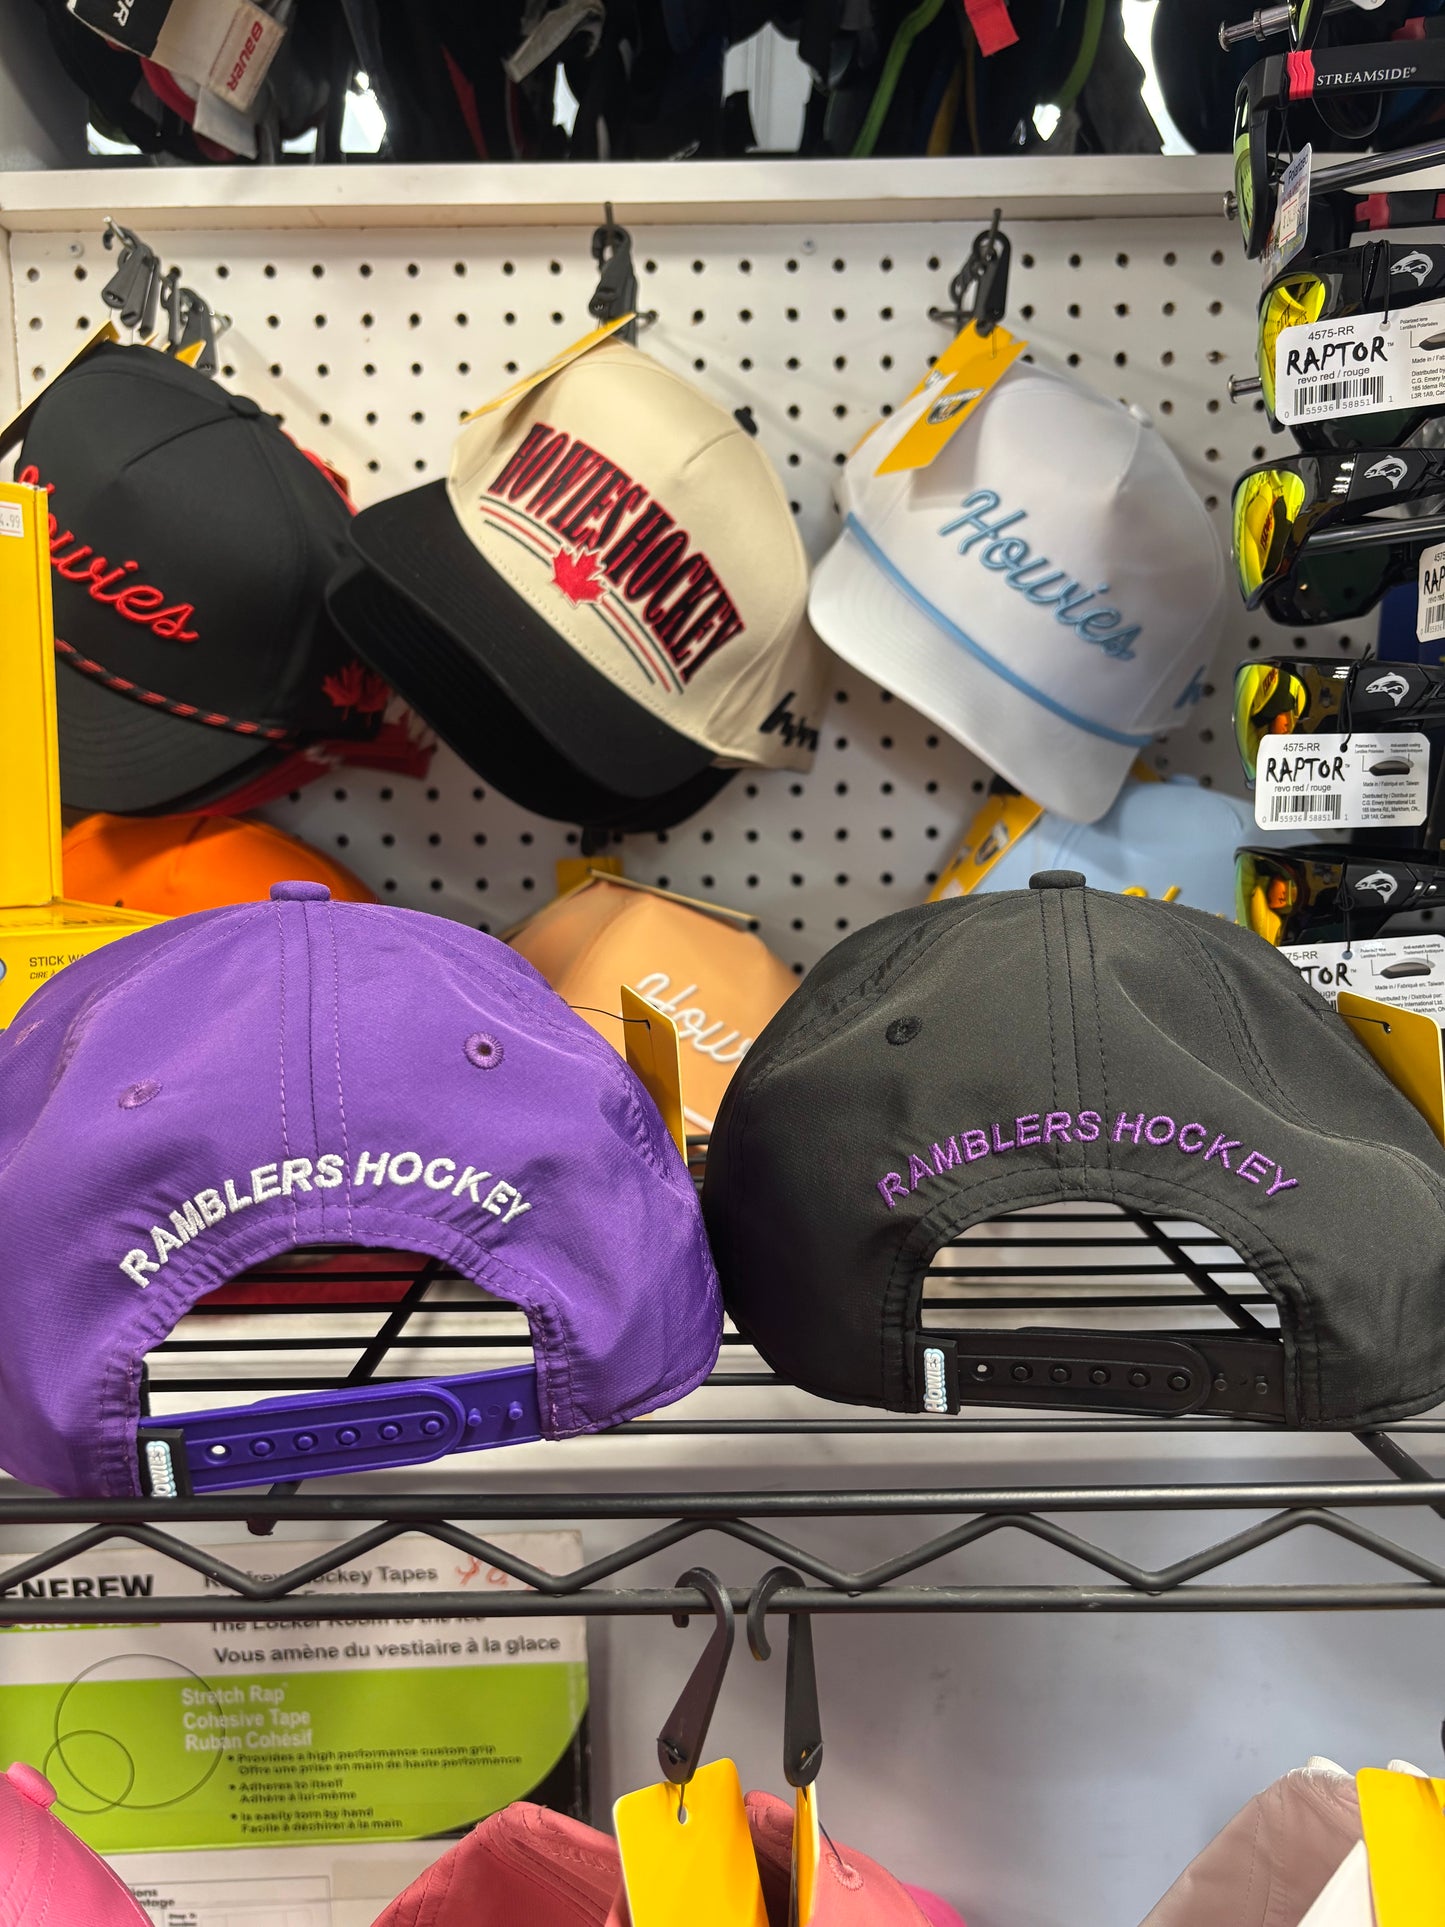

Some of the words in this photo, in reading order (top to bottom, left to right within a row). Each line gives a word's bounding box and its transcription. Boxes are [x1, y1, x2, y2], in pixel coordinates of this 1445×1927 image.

[1308, 325, 1355, 341] 4575-RR
[1297, 375, 1317, 385] revo
[1319, 370, 1335, 381] red
[1337, 369, 1342, 379] /
[1343, 366, 1370, 379] rouge
[1412, 368, 1438, 377] Distributed
[1284, 411, 1290, 419] 0
[1305, 405, 1334, 415] 55936
[1342, 399, 1371, 410] 58851
[1388, 395, 1393, 403] 1
[937, 489, 1144, 662] Howies
[601, 499, 747, 687] HOCKEY
[1283, 743, 1320, 752] 4575-RR
[1274, 784, 1291, 793] revo
[1292, 783, 1304, 792] red
[1310, 784, 1332, 794] rouge
[1262, 815, 1266, 823] 0
[1280, 815, 1302, 823] 55936
[1309, 814, 1331, 822] 58851
[29, 955, 65, 967] STICK
[1287, 951, 1318, 961] 75-RR
[30, 971, 48, 980] CIRE
[876, 1110, 1101, 1209] RAMBLERS
[1110, 1111, 1300, 1198] HOCKEY
[119, 1154, 346, 1289] RAMBLERS
[354, 1151, 533, 1224] HOCKEY
[306, 1567, 372, 1588] ockey
[378, 1565, 438, 1584] Tapes
[214, 1647, 267, 1664] Vous
[271, 1642, 346, 1661] amène
[349, 1642, 372, 1659] du
[376, 1637, 462, 1657] vestiaire
[467, 1636, 479, 1654] à
[483, 1635, 502, 1652] la
[506, 1635, 561, 1655] glace
[181, 1685, 245, 1706] Stretch
[183, 1711, 264, 1730] Cohesive
[269, 1708, 311, 1729] Tape
[185, 1733, 243, 1752] Ruban
[237, 1753, 295, 1764] Provides
[309, 1750, 335, 1763] high
[339, 1748, 418, 1762] performance
[421, 1746, 469, 1756] custom
[471, 1744, 496, 1756] grip
[239, 1764, 271, 1775] Offre
[403, 1758, 440, 1769] haute
[441, 1756, 522, 1769] performance
[341, 1807, 374, 1818] hand
[371, 1818, 403, 1829] main
